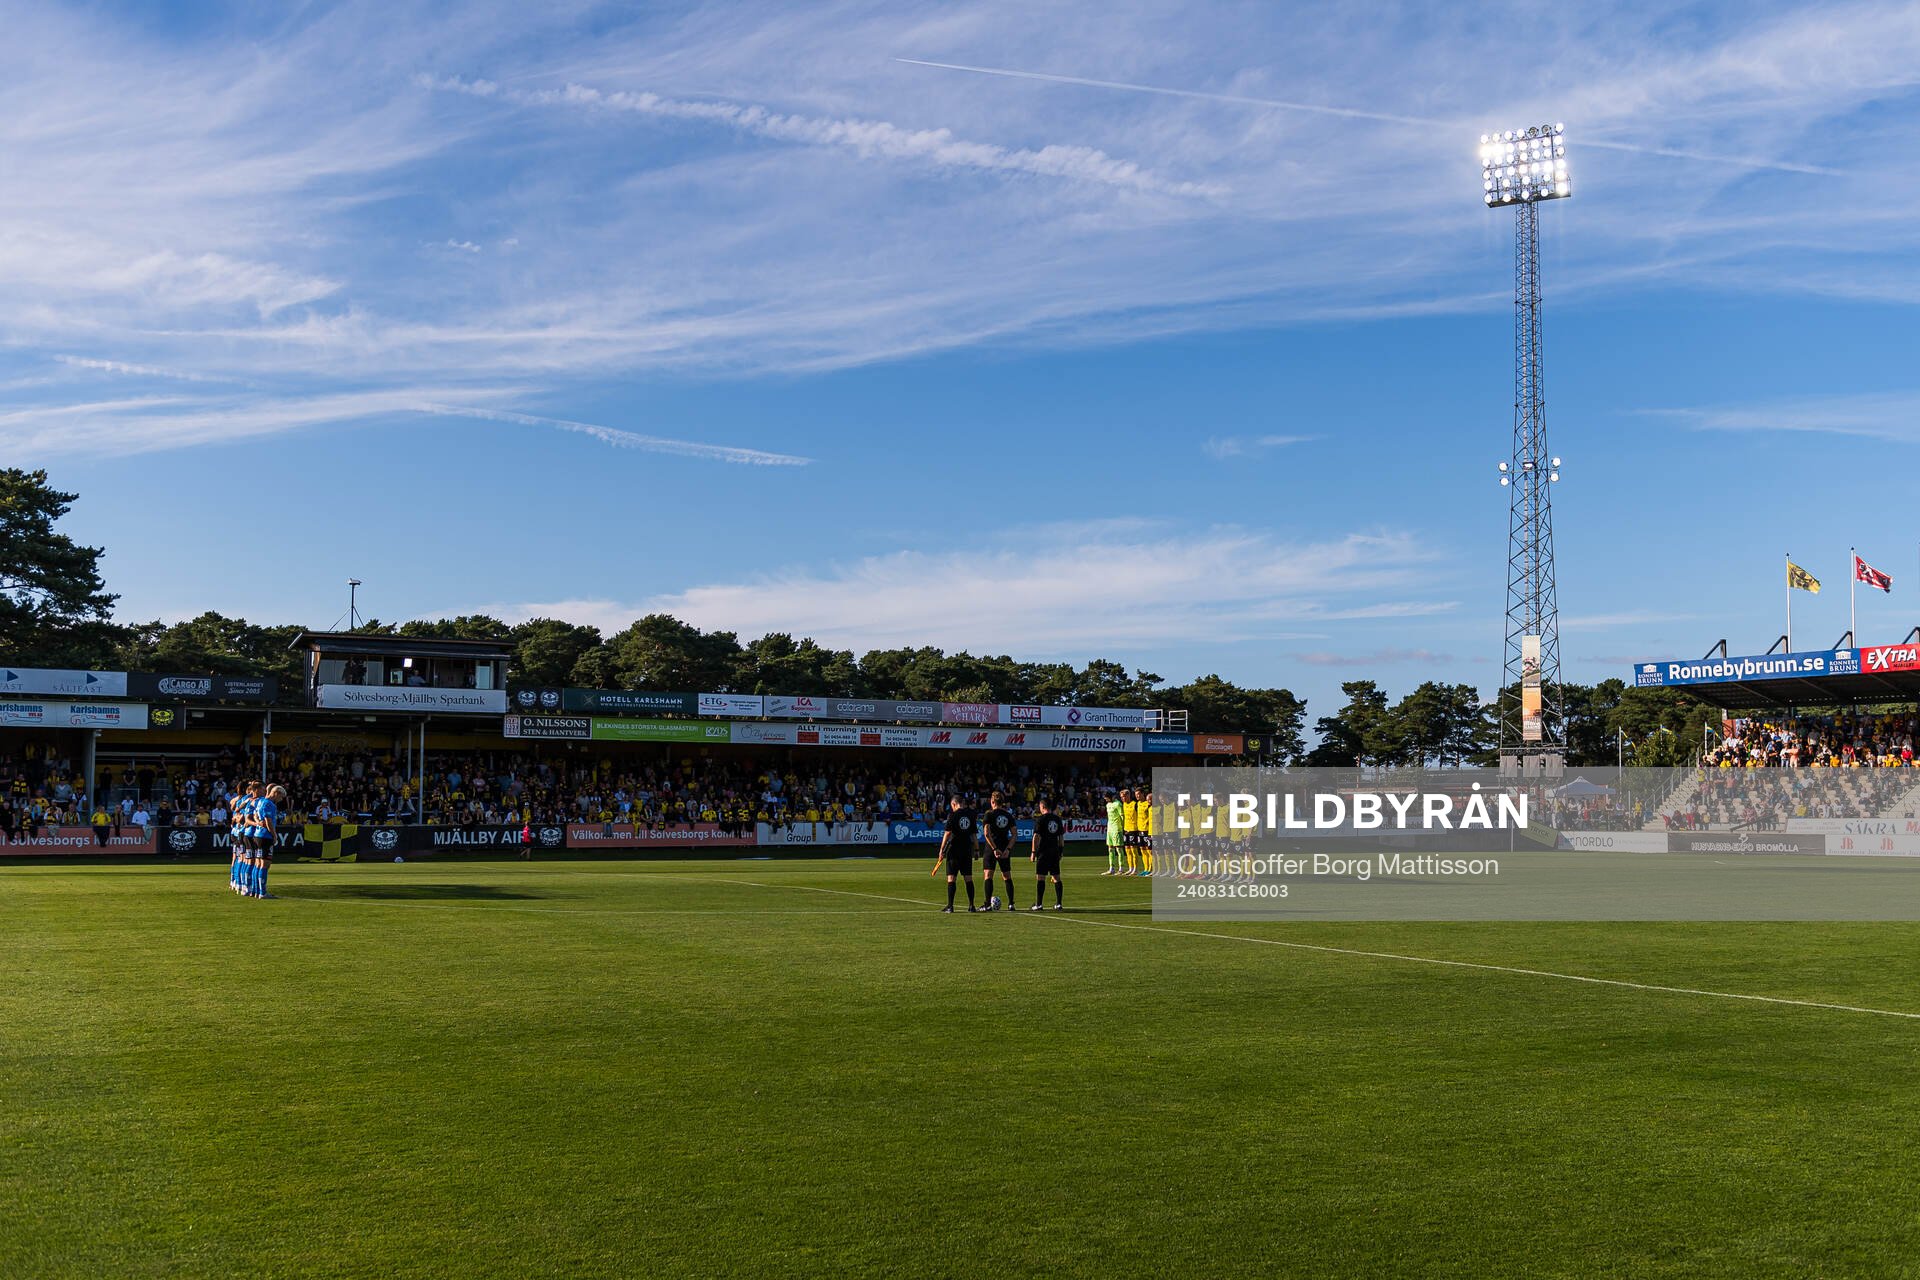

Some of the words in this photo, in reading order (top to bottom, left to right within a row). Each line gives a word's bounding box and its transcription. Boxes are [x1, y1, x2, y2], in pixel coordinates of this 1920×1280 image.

[1669, 658, 1824, 680] Ronnebybrunn.se
[344, 692, 437, 705] Sölvesborg-Mjällby
[440, 694, 485, 707] Sparbank
[635, 697, 682, 705] KARLSHAMN
[797, 697, 812, 706] ICA
[70, 705, 120, 715] Karlshamns
[837, 701, 875, 712] colorama
[896, 703, 933, 715] colorama
[955, 713, 988, 722] CHARK
[1012, 708, 1039, 718] SAVE
[1085, 712, 1107, 722] Grant
[1108, 713, 1144, 724] Thornton
[524, 719, 535, 727] O.
[537, 719, 587, 728] NILSSONS
[1052, 733, 1126, 749] bilmånsson
[854, 824, 863, 833] IV
[1845, 820, 1897, 835] SÄKRA
[434, 828, 497, 845] MJÄLLBY
[572, 829, 632, 840] Välkomen
[786, 834, 811, 843] Group
[853, 833, 878, 842] Group
[1755, 843, 1799, 853] BROMÖLLA
[1841, 838, 1853, 849] JB
[1881, 838, 1894, 850] JB
